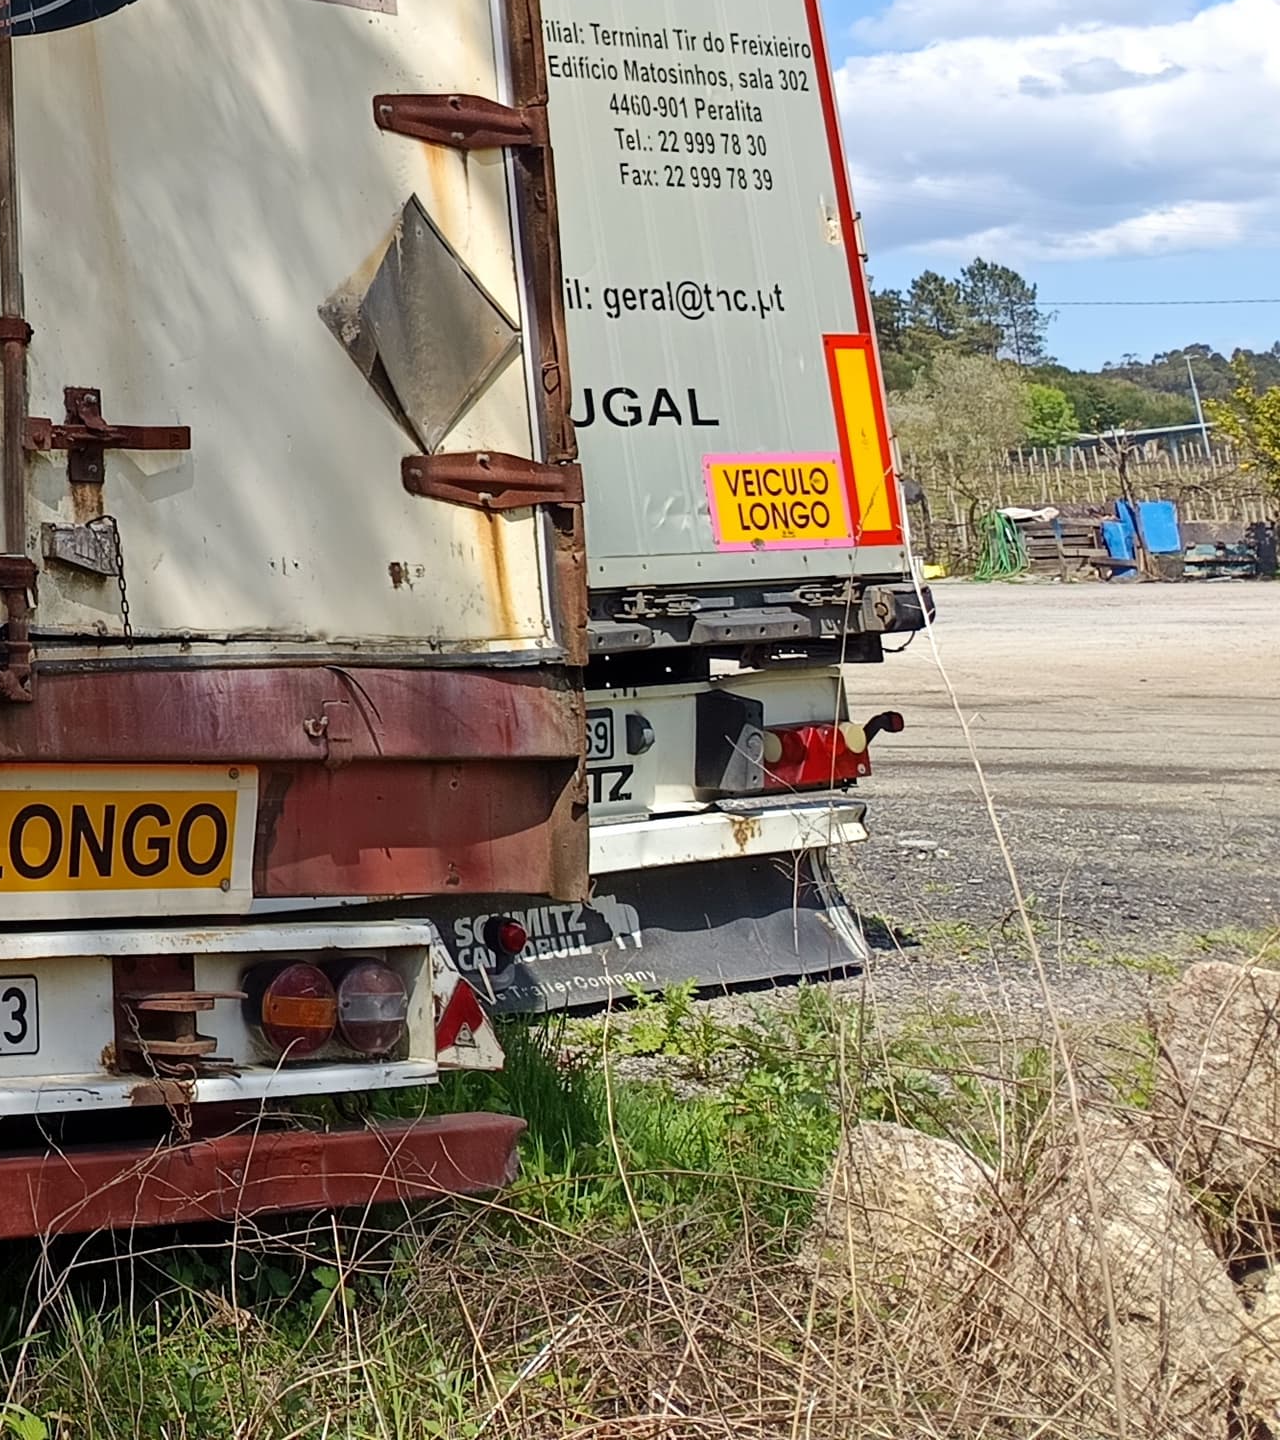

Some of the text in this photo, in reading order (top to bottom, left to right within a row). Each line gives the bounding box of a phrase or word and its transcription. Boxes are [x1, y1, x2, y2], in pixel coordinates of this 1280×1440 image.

[541, 20, 811, 59] ilial: Terminal Tir do Freixieiro
[548, 55, 810, 92] Edifício Matosinhos, sala 302
[609, 94, 689, 120] 4460-901
[614, 128, 768, 156] Tel.: 22 999 78 30
[620, 163, 774, 191] Fax: 22 999 78 39
[723, 468, 829, 497] VEICULO
[738, 500, 830, 531] LONGO
[453, 902, 587, 948] SCMITZ
